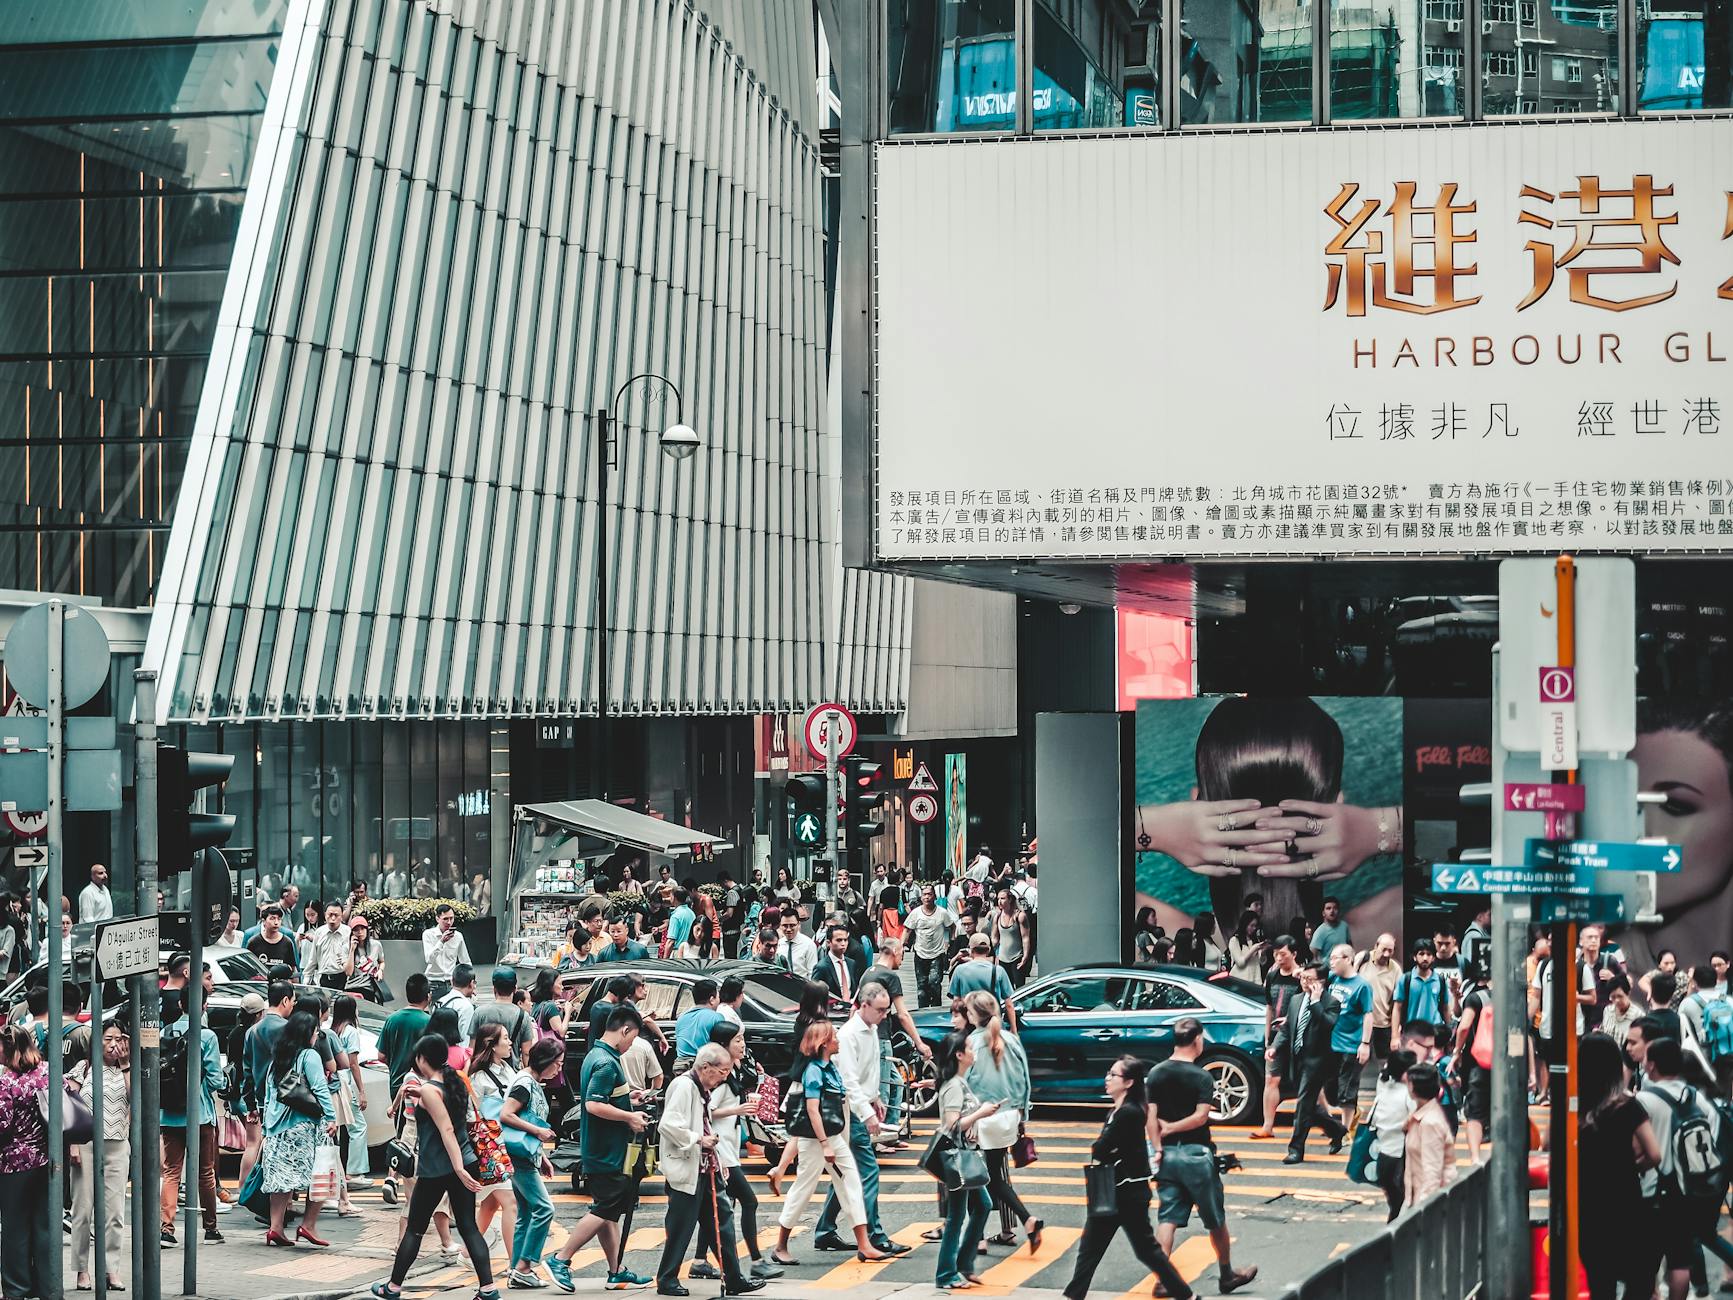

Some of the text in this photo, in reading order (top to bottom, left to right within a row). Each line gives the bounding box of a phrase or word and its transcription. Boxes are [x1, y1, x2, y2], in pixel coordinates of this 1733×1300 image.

[1322, 174, 1733, 318] 維港
[1354, 331, 1727, 369] HARBOUR GL
[1326, 397, 1720, 441] 位據非凡 經世港
[542, 726, 560, 740] GAP
[1551, 711, 1564, 765] Central
[1416, 746, 1452, 773] Folli
[1558, 857, 1581, 866] Peak
[1482, 883, 1510, 892] Central
[107, 926, 158, 946] D'Aguilar Street
